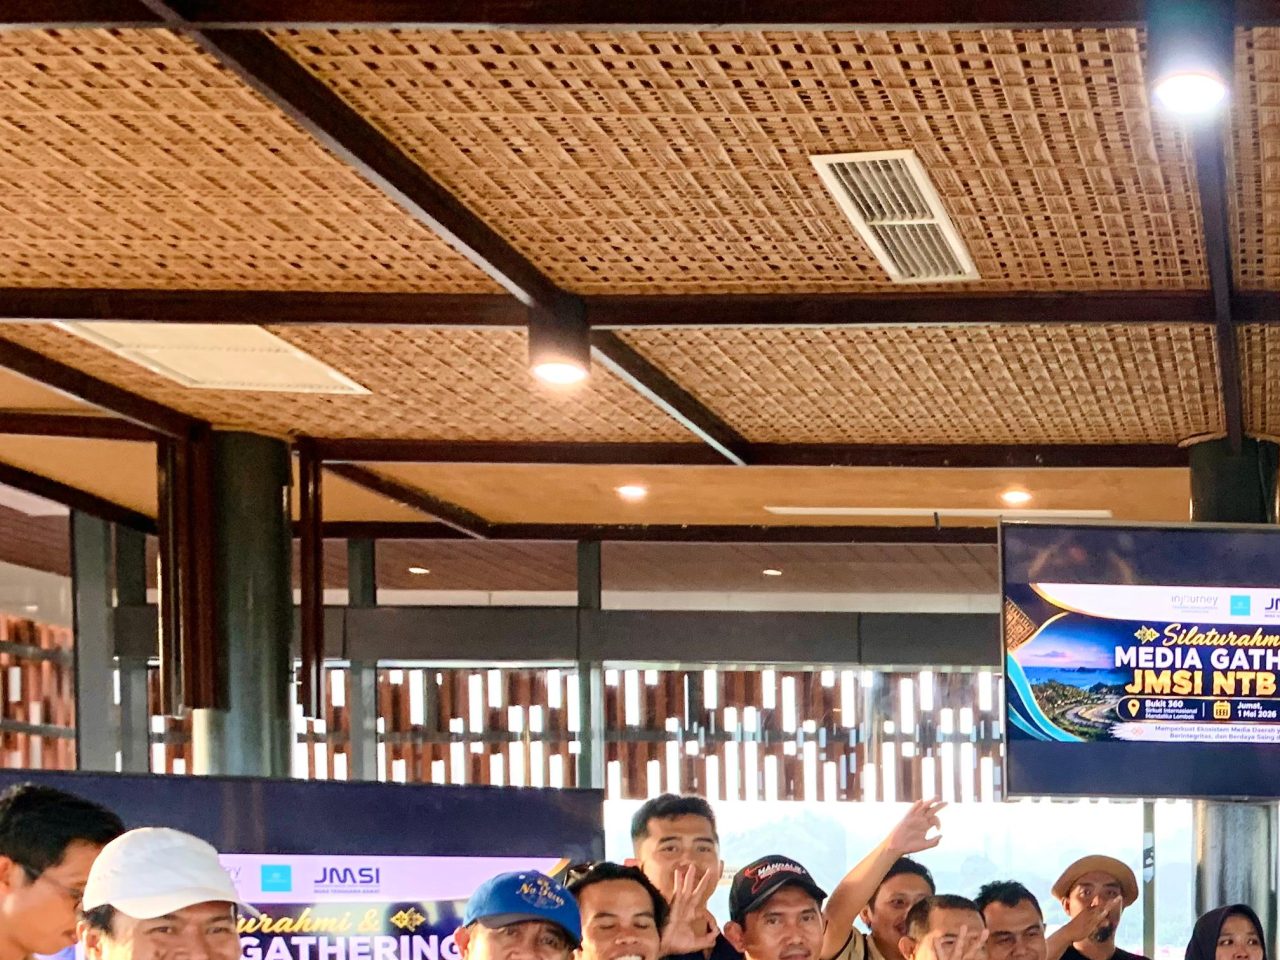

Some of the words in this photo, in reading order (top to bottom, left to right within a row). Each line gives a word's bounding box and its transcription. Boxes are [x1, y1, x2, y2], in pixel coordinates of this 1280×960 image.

[1115, 646, 1203, 669] MEDIA
[1125, 669, 1203, 695] JMSI
[1212, 671, 1277, 696] NTB
[1145, 700, 1166, 708] Bukit
[1168, 700, 1184, 708] 360
[1237, 702, 1262, 710] Jumat,
[1243, 710, 1256, 718] Mei
[1258, 710, 1277, 718] 2026
[314, 867, 380, 884] JMSI
[238, 907, 352, 933] urahmi
[358, 909, 379, 932] &
